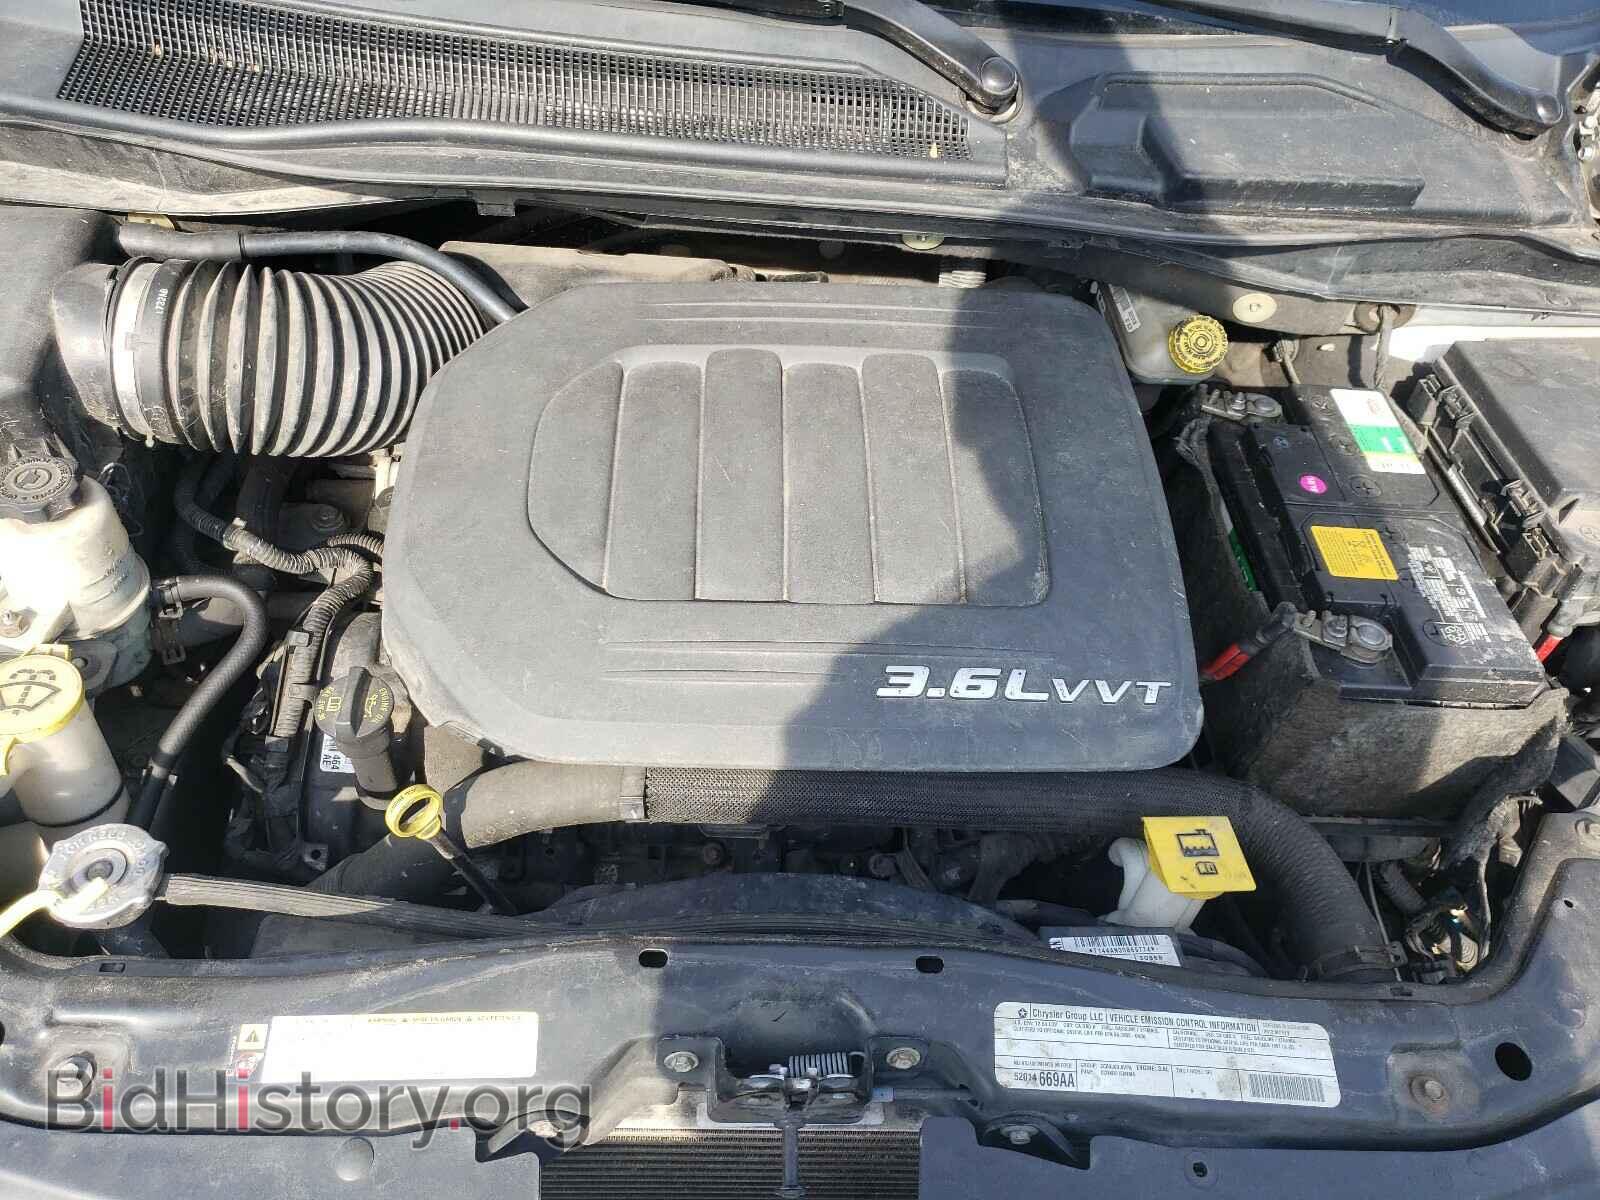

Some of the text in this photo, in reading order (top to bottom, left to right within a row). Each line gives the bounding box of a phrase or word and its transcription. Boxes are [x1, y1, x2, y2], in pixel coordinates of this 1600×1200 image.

[876, 665, 1172, 704] 3.6L VVT
[1032, 1008, 1063, 1021] Chrysler
[1065, 1010, 1087, 1022] Group
[1089, 1012, 1103, 1022] LLC
[1109, 1013, 1139, 1024] VEHICLE
[1141, 1015, 1174, 1026] EMISSION
[1176, 1017, 1208, 1029] CONTROL
[1209, 1020, 1256, 1032] INFORMATION
[1039, 1071, 1075, 1088] 669AA
